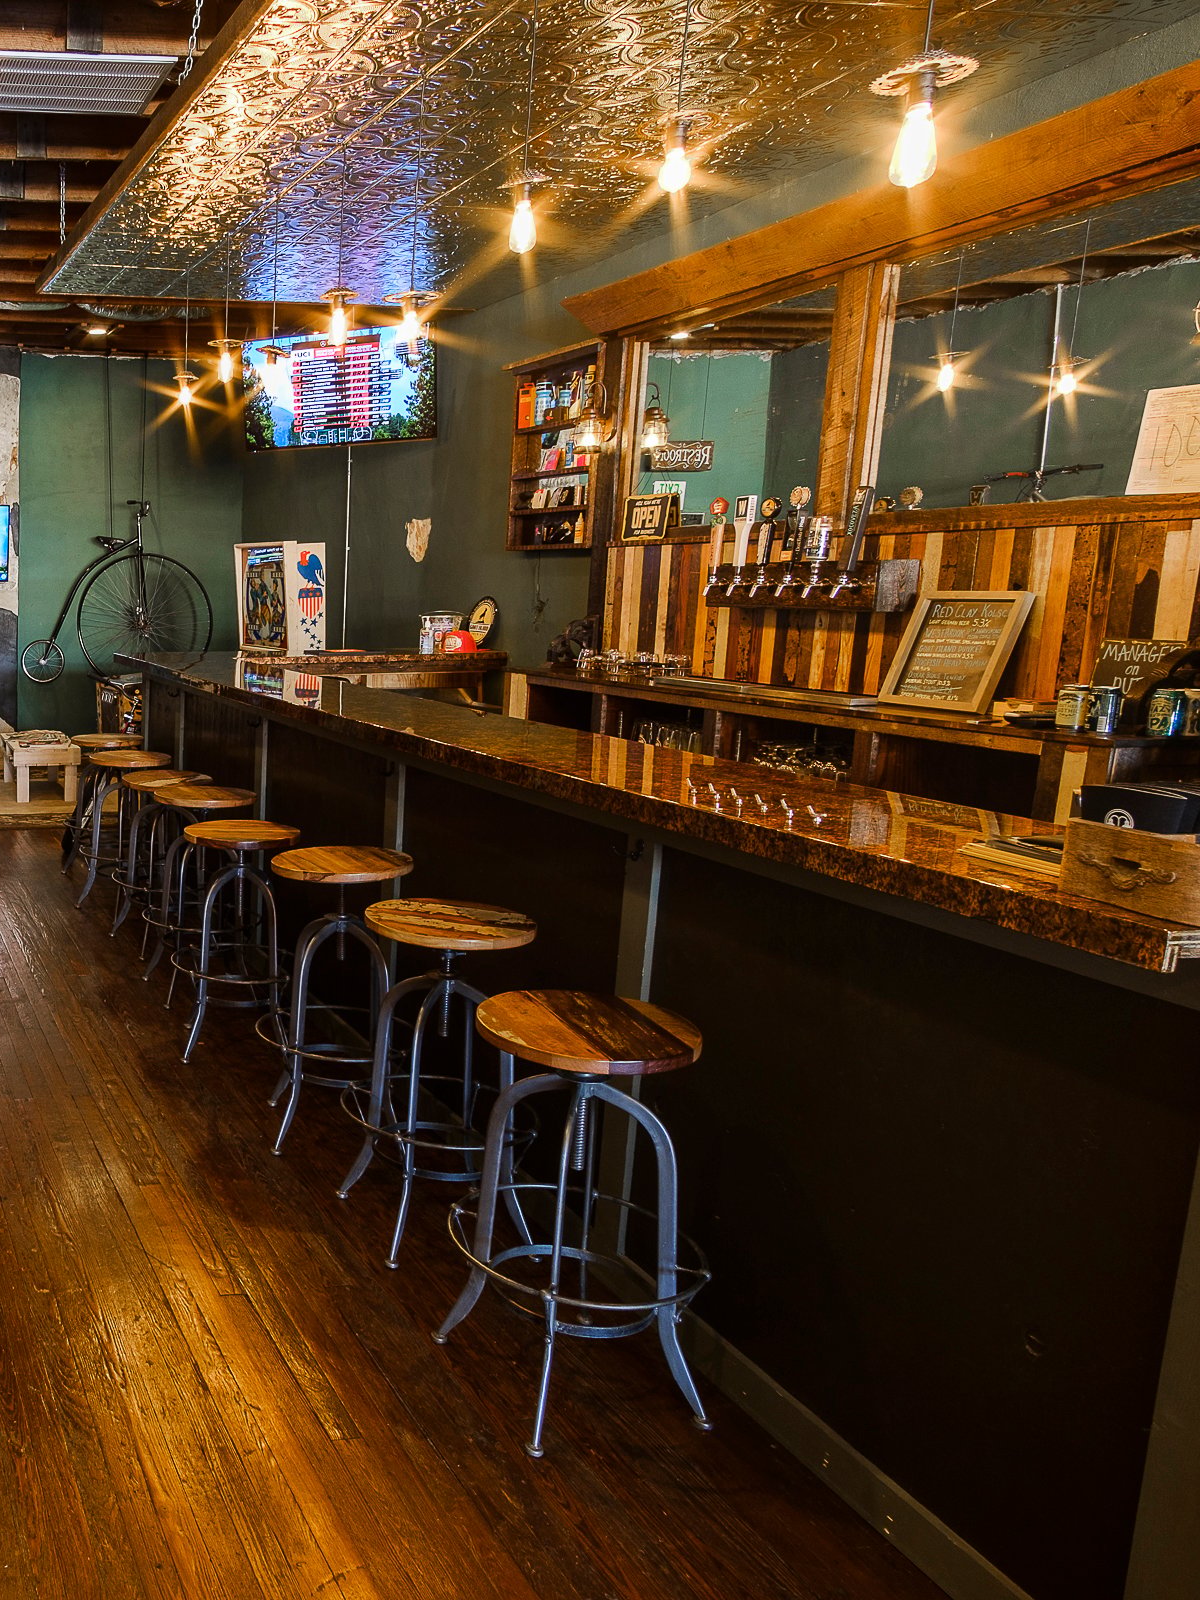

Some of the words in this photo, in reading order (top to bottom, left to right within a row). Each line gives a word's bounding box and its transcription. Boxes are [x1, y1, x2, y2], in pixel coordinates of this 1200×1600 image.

[738, 499, 747, 517] W
[631, 505, 661, 528] OPEN
[932, 604, 953, 618] RED
[955, 603, 978, 618] CLAY
[971, 618, 991, 627] 5.3%
[1125, 665, 1140, 676] on
